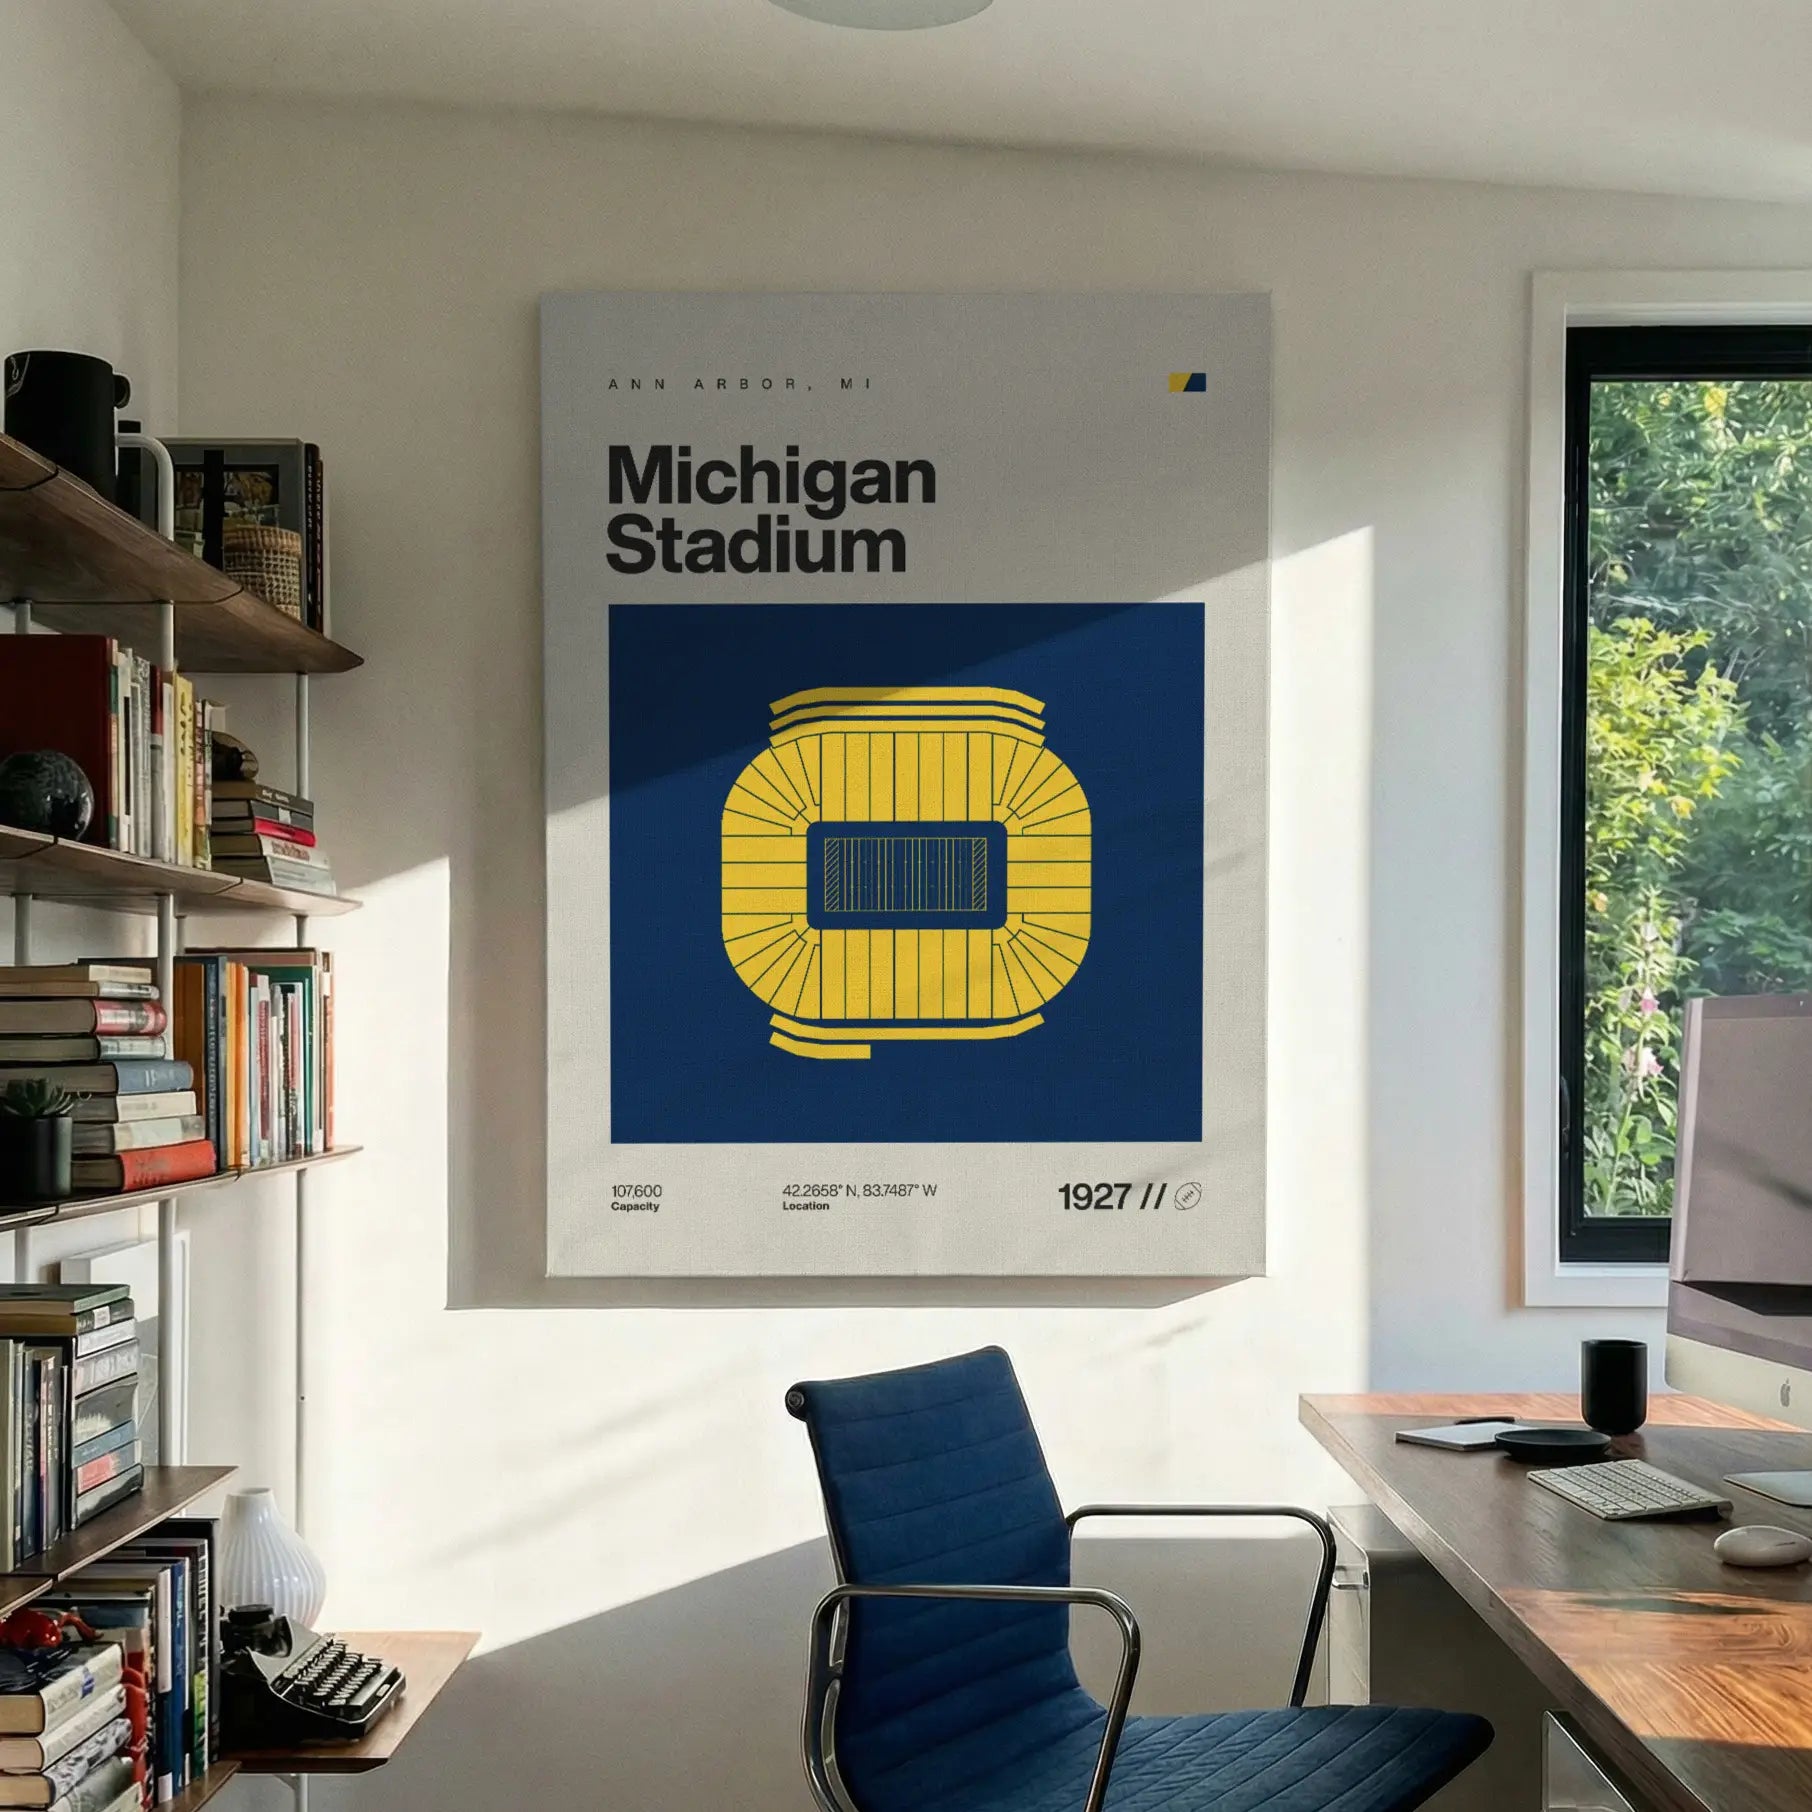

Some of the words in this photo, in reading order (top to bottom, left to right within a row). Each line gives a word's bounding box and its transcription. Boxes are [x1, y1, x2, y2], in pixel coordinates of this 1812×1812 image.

[608, 378, 666, 390] ANN
[693, 378, 812, 391] ARBOR,
[840, 378, 871, 390] MI
[608, 445, 936, 520] Michigan
[606, 513, 906, 574] Stadium
[611, 1184, 662, 1199] 107,600
[782, 1184, 844, 1197] 42.2658°
[846, 1184, 860, 1199] N,
[863, 1184, 920, 1198] 83.7487°
[922, 1184, 937, 1197] W
[1058, 1183, 1132, 1210] 1927
[611, 1202, 660, 1213] Capacity
[782, 1201, 830, 1211] Location
